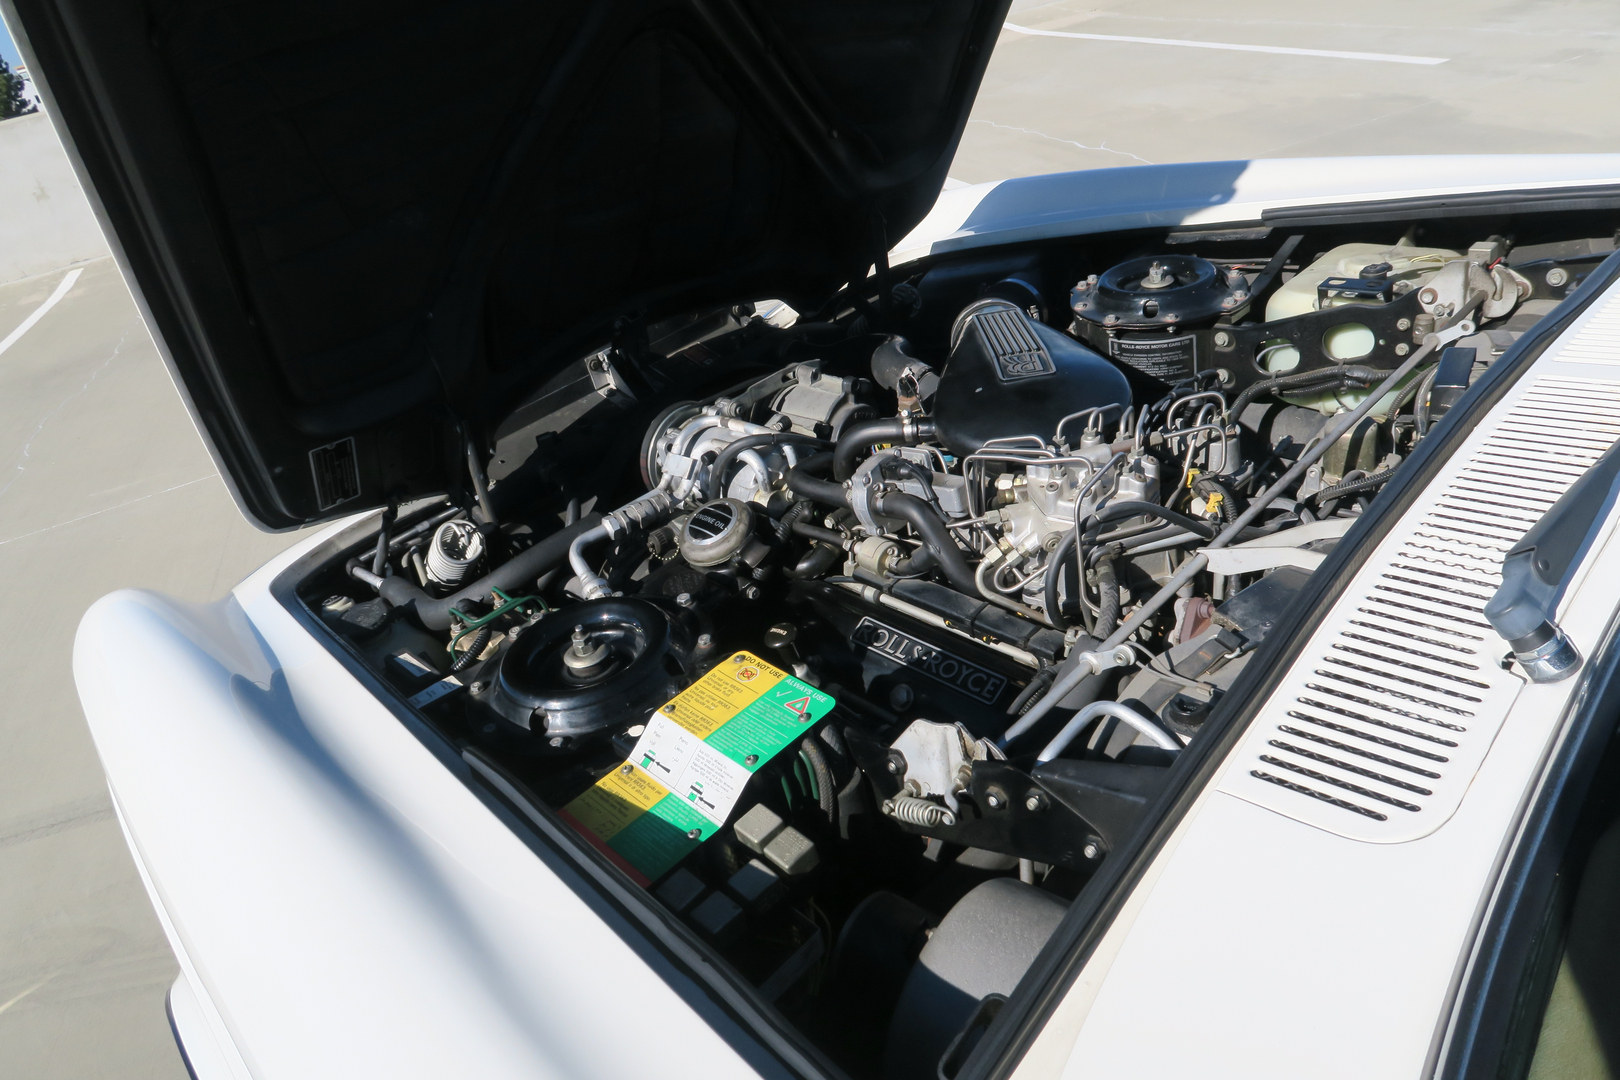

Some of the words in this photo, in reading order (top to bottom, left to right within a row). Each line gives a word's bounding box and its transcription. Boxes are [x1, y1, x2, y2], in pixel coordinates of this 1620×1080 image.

[696, 514, 716, 525] ENGINE
[714, 520, 725, 530] OIL
[744, 655, 757, 664] DO
[754, 661, 770, 671] NOT
[768, 668, 783, 678] USE
[784, 677, 813, 695] ALWAYS
[810, 692, 828, 703] USE
